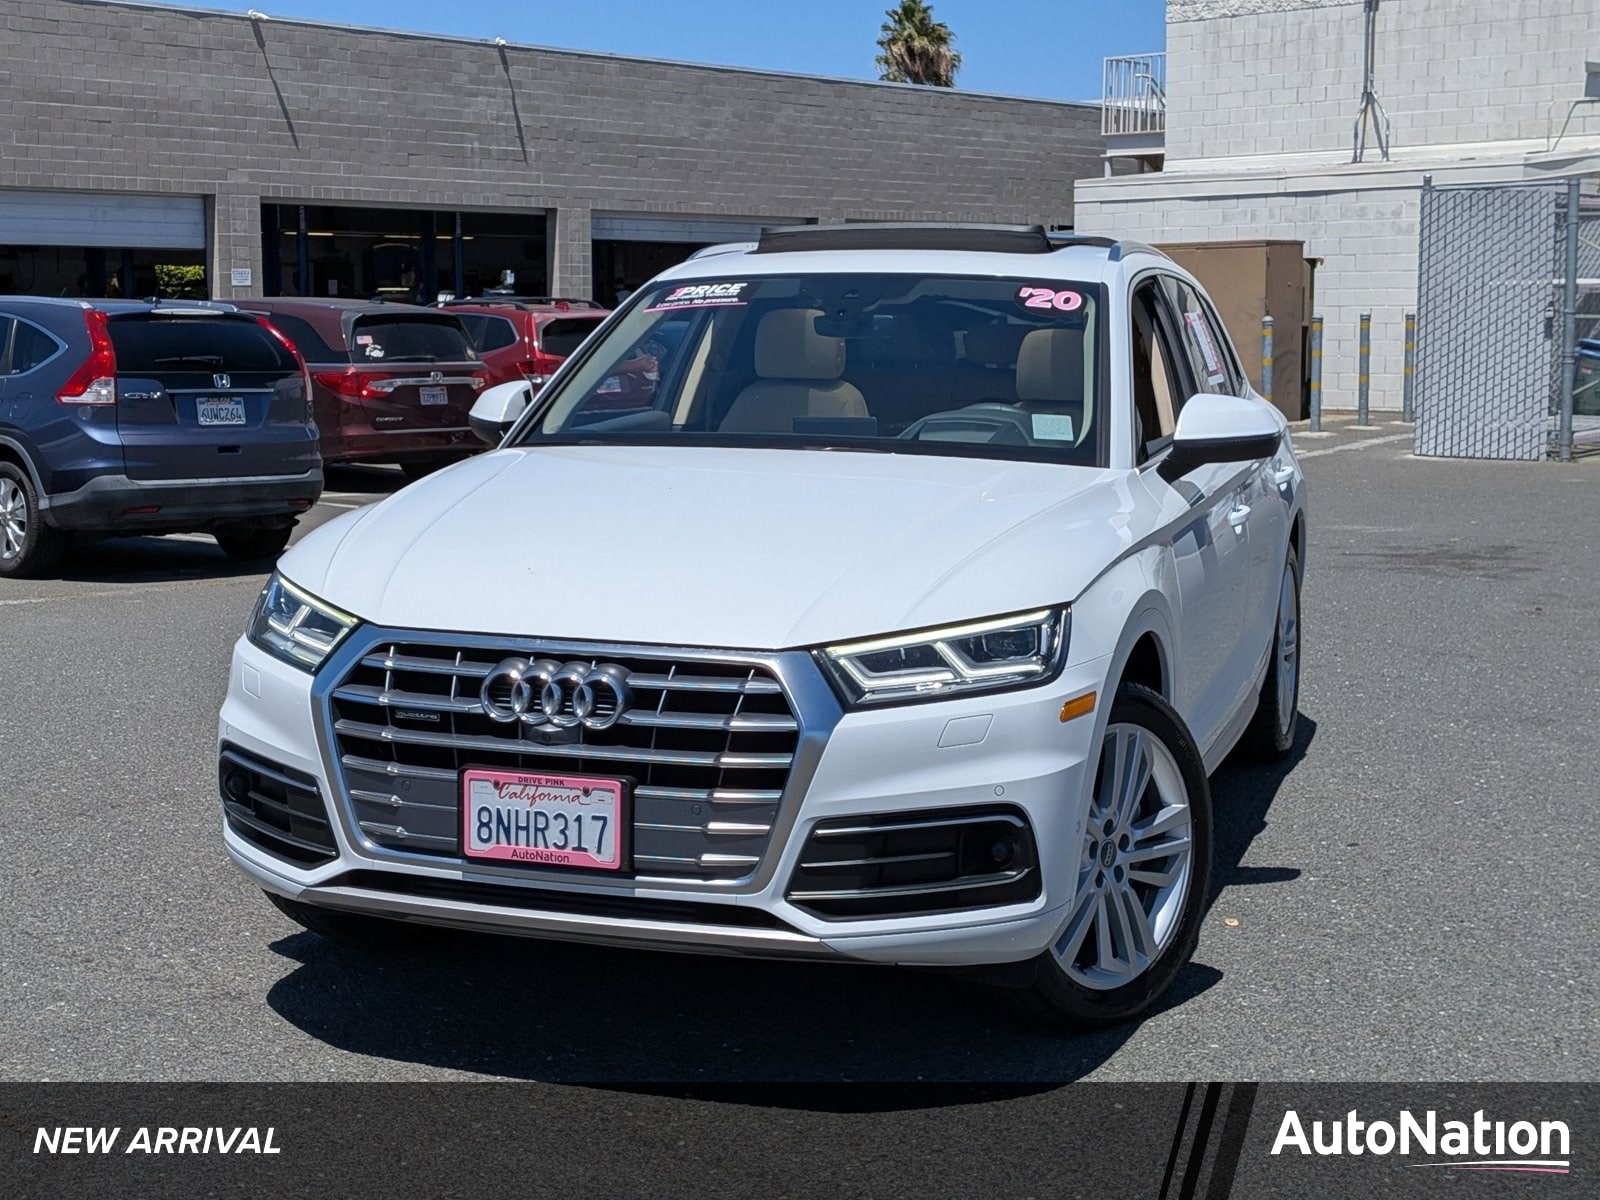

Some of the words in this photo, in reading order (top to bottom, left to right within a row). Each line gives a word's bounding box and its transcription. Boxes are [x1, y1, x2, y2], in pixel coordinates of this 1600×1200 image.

[1019, 287, 1082, 311] '20
[518, 776, 542, 785] DRIVE
[545, 778, 565, 786] PINK
[498, 783, 591, 807] California
[477, 806, 608, 854] 8NHR317
[511, 849, 570, 864] AutoNation
